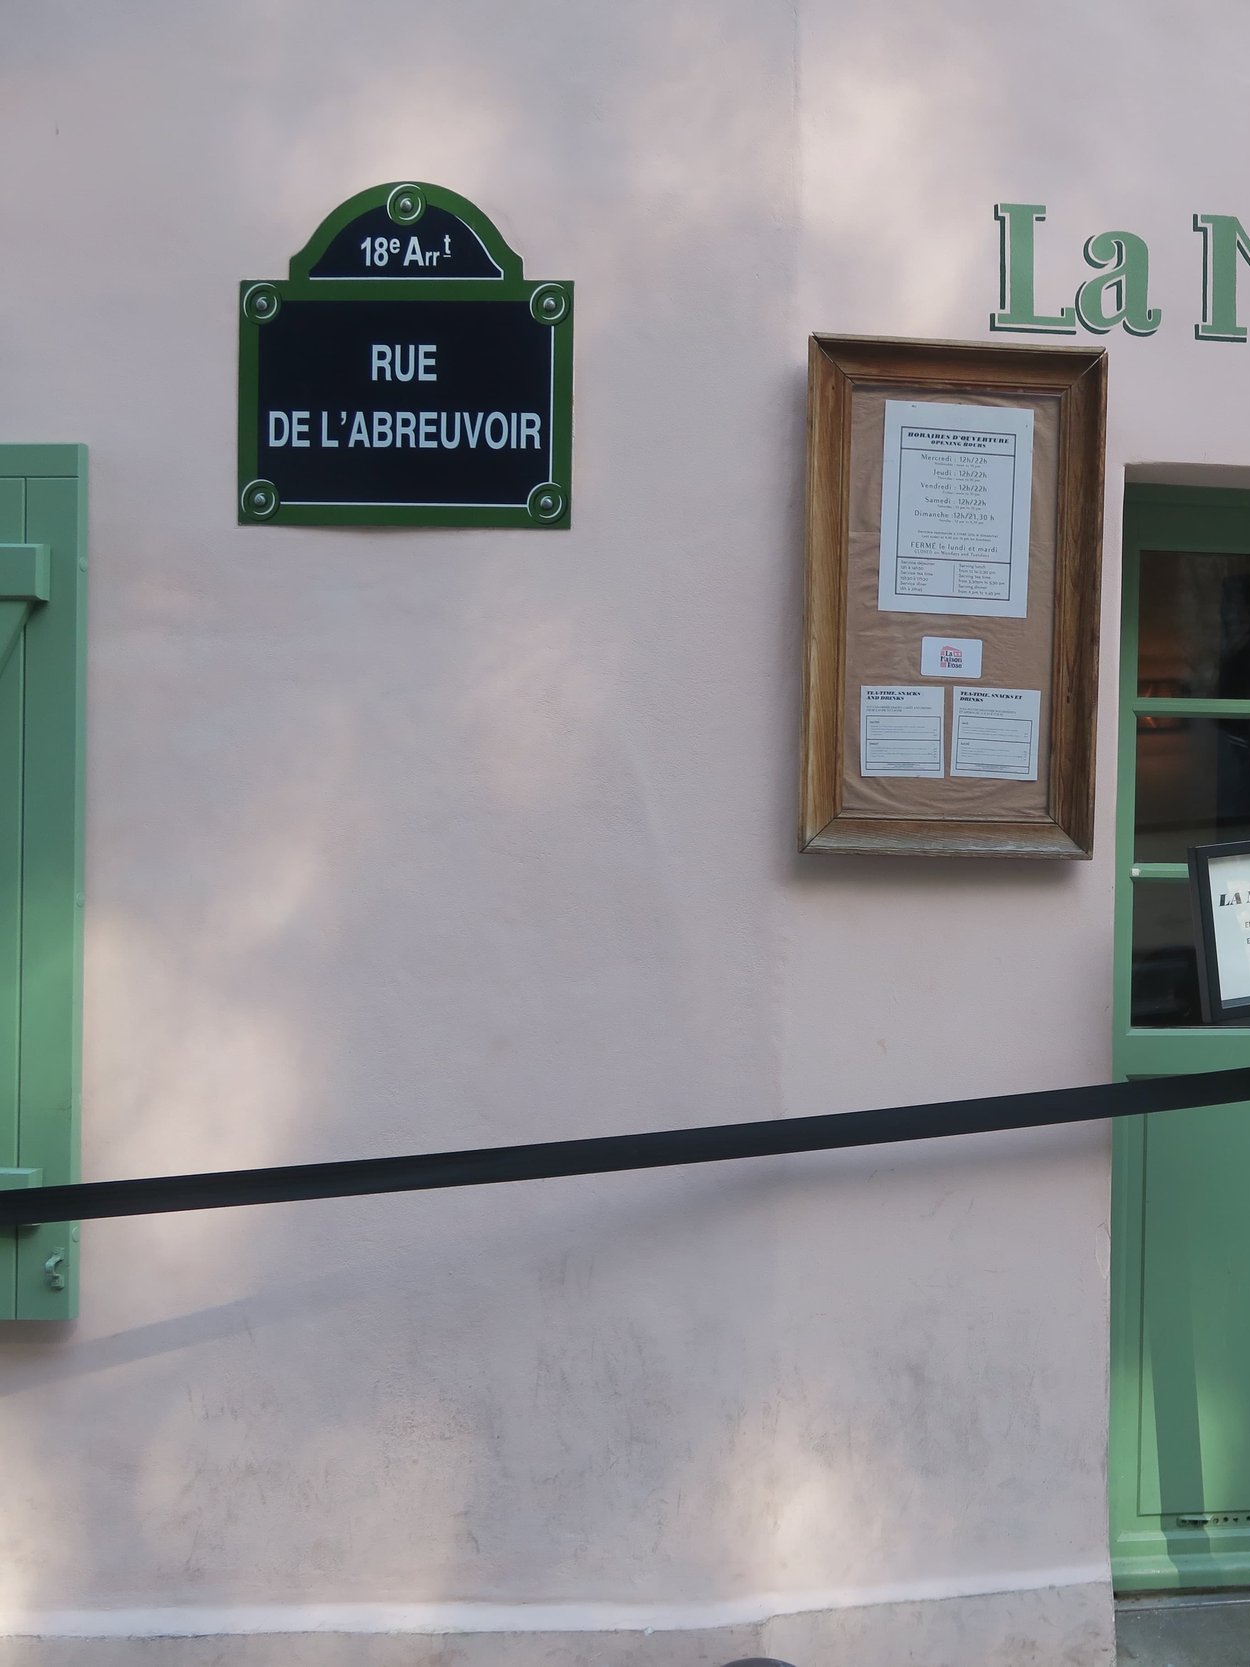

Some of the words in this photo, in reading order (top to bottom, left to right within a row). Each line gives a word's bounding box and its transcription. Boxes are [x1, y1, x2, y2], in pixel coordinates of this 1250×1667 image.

[361, 236, 400, 267] 18e
[989, 203, 1162, 337] La
[371, 344, 437, 382] RUE
[268, 411, 310, 448] DE
[321, 411, 542, 450] L'ABREUVOIR
[908, 432, 950, 440] HORAIRES
[952, 434, 1010, 444] D'OUVERTURE
[921, 453, 952, 462] Mercredi
[960, 456, 988, 465] 12h/22h
[932, 468, 952, 477] Jeudi
[958, 470, 988, 479] 12h/22h
[920, 482, 952, 490] Vendredi
[958, 484, 988, 493] 12h/22h
[924, 496, 952, 505] Samedi
[958, 498, 987, 506] 12h/22h
[914, 510, 950, 518] Dimanche
[910, 542, 936, 550] FERMÉ
[1219, 892, 1242, 907] LA
